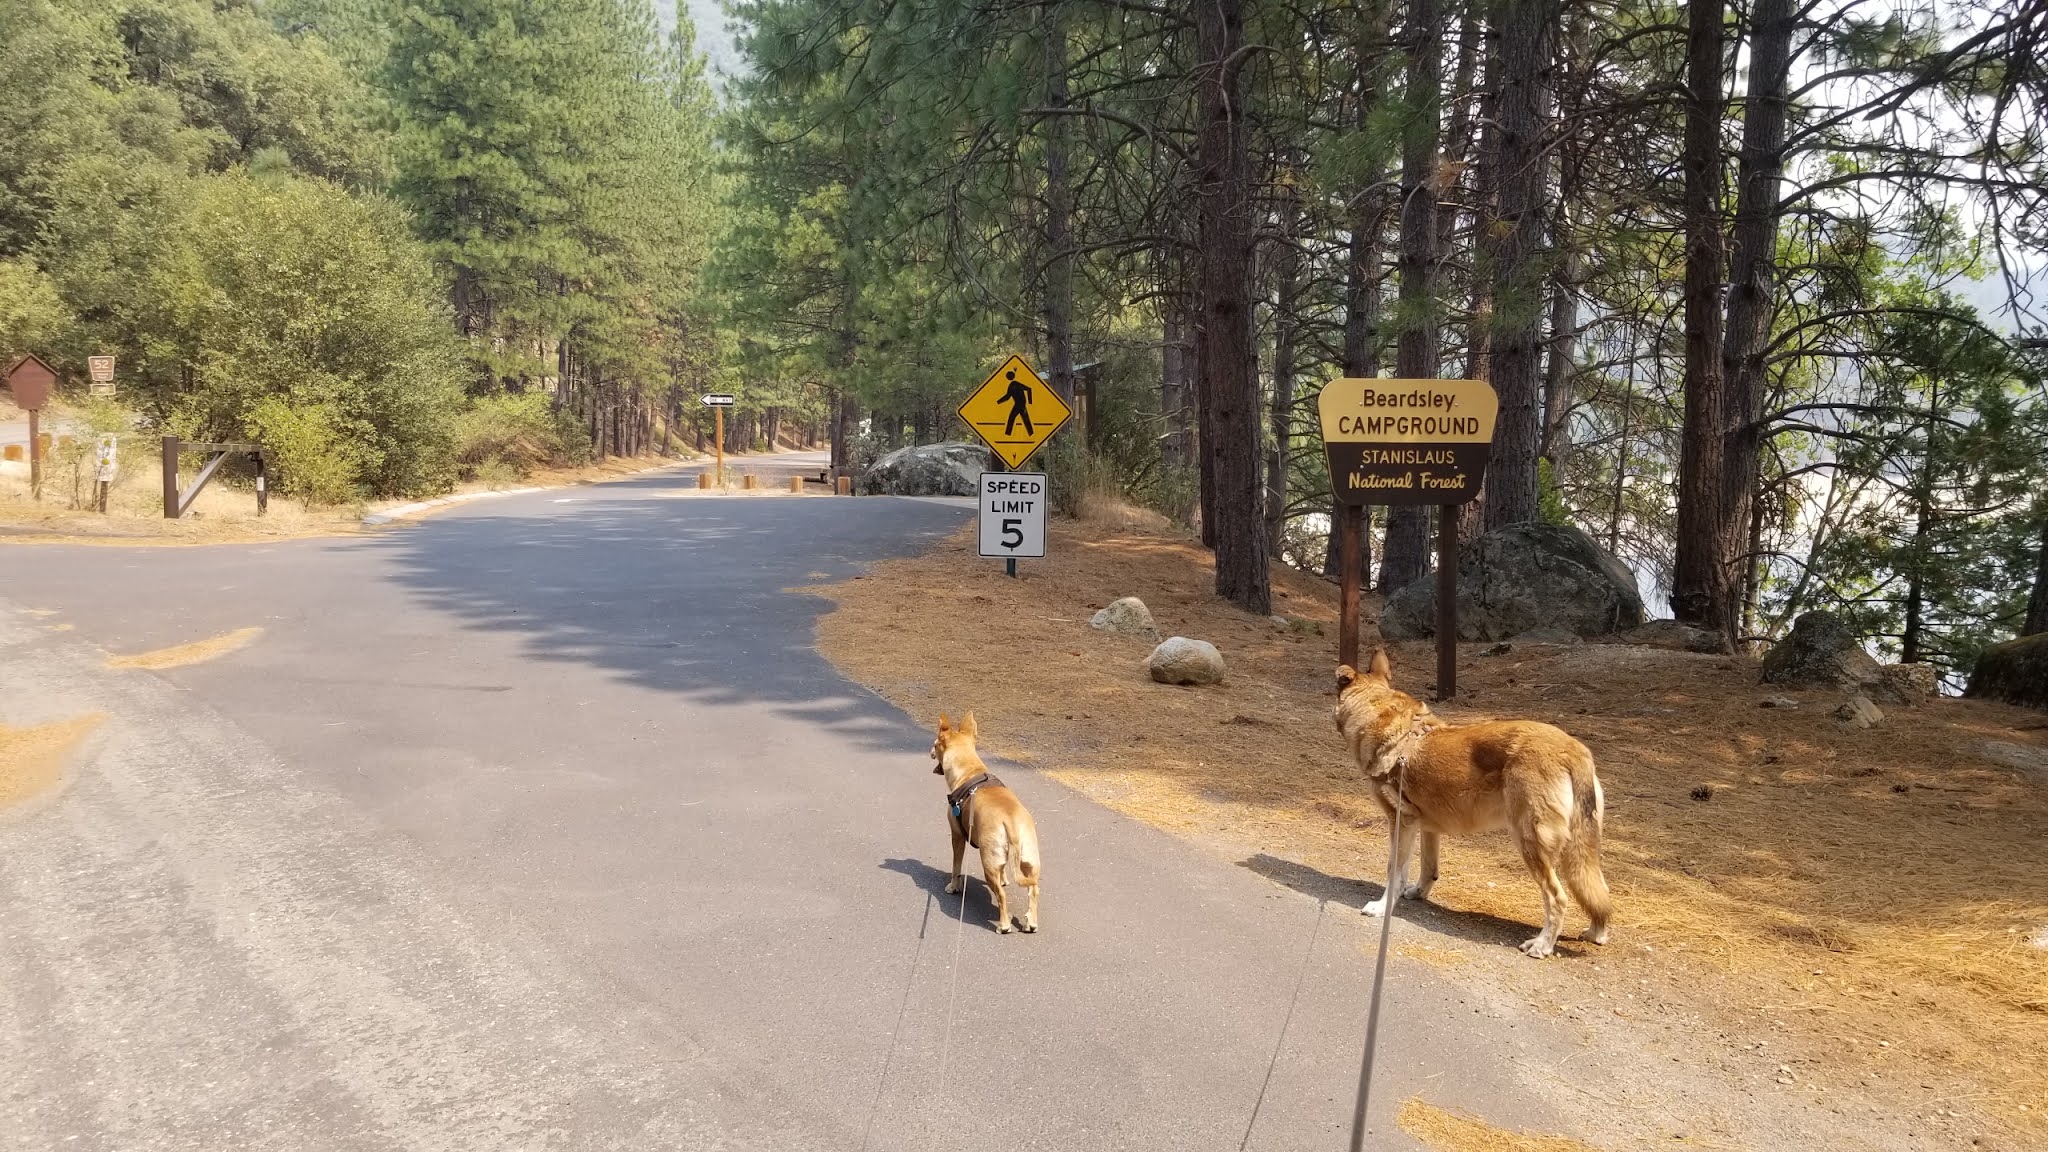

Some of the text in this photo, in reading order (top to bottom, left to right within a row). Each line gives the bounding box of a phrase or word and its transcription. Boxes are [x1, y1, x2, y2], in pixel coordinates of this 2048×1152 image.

[95, 359, 109, 369] 52
[1363, 389, 1456, 412] Beardsley
[1338, 416, 1479, 435] CAMPGROUND
[1362, 450, 1455, 464] STANISLAUS
[987, 481, 1041, 494] SPEED
[1348, 472, 1466, 489] National Forest
[991, 500, 1034, 513] LIMIT
[1000, 518, 1024, 549] 5
